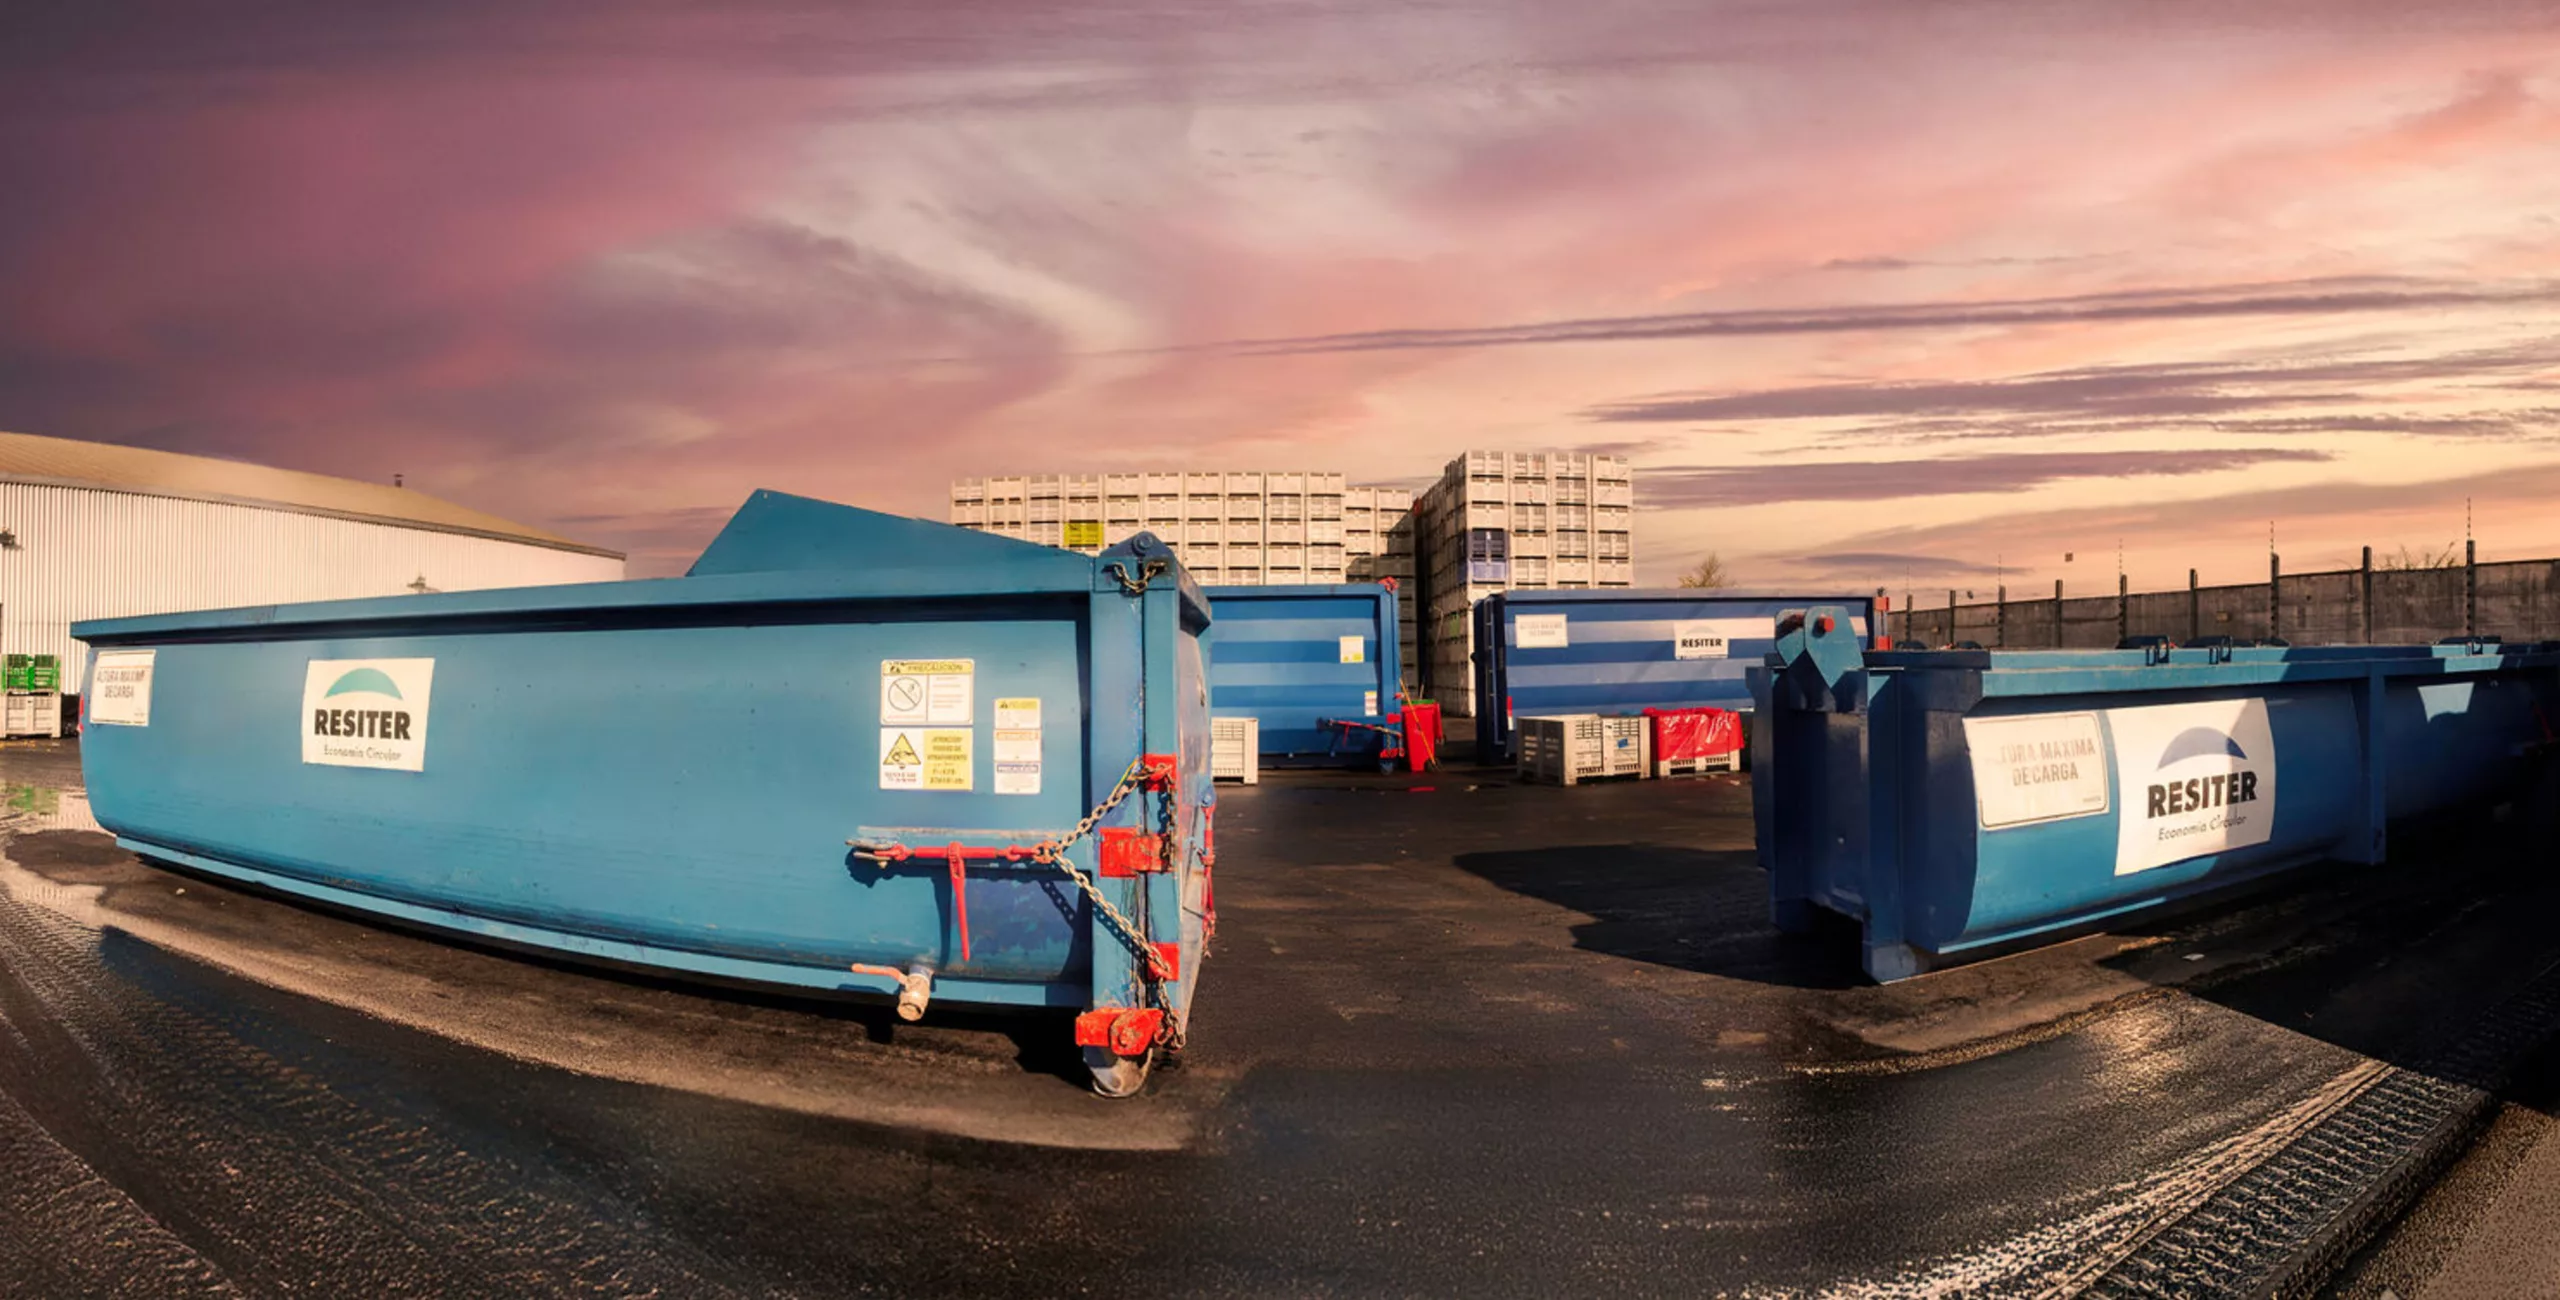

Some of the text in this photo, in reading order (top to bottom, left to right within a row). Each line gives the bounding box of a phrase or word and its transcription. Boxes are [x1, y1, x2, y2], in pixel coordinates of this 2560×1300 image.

[1681, 638, 1722, 648] RESITER
[314, 708, 411, 741] RESITER
[2039, 738, 2096, 761] MAXIMA
[2012, 762, 2079, 787] DE CARGA
[2147, 770, 2258, 820] RESITER
